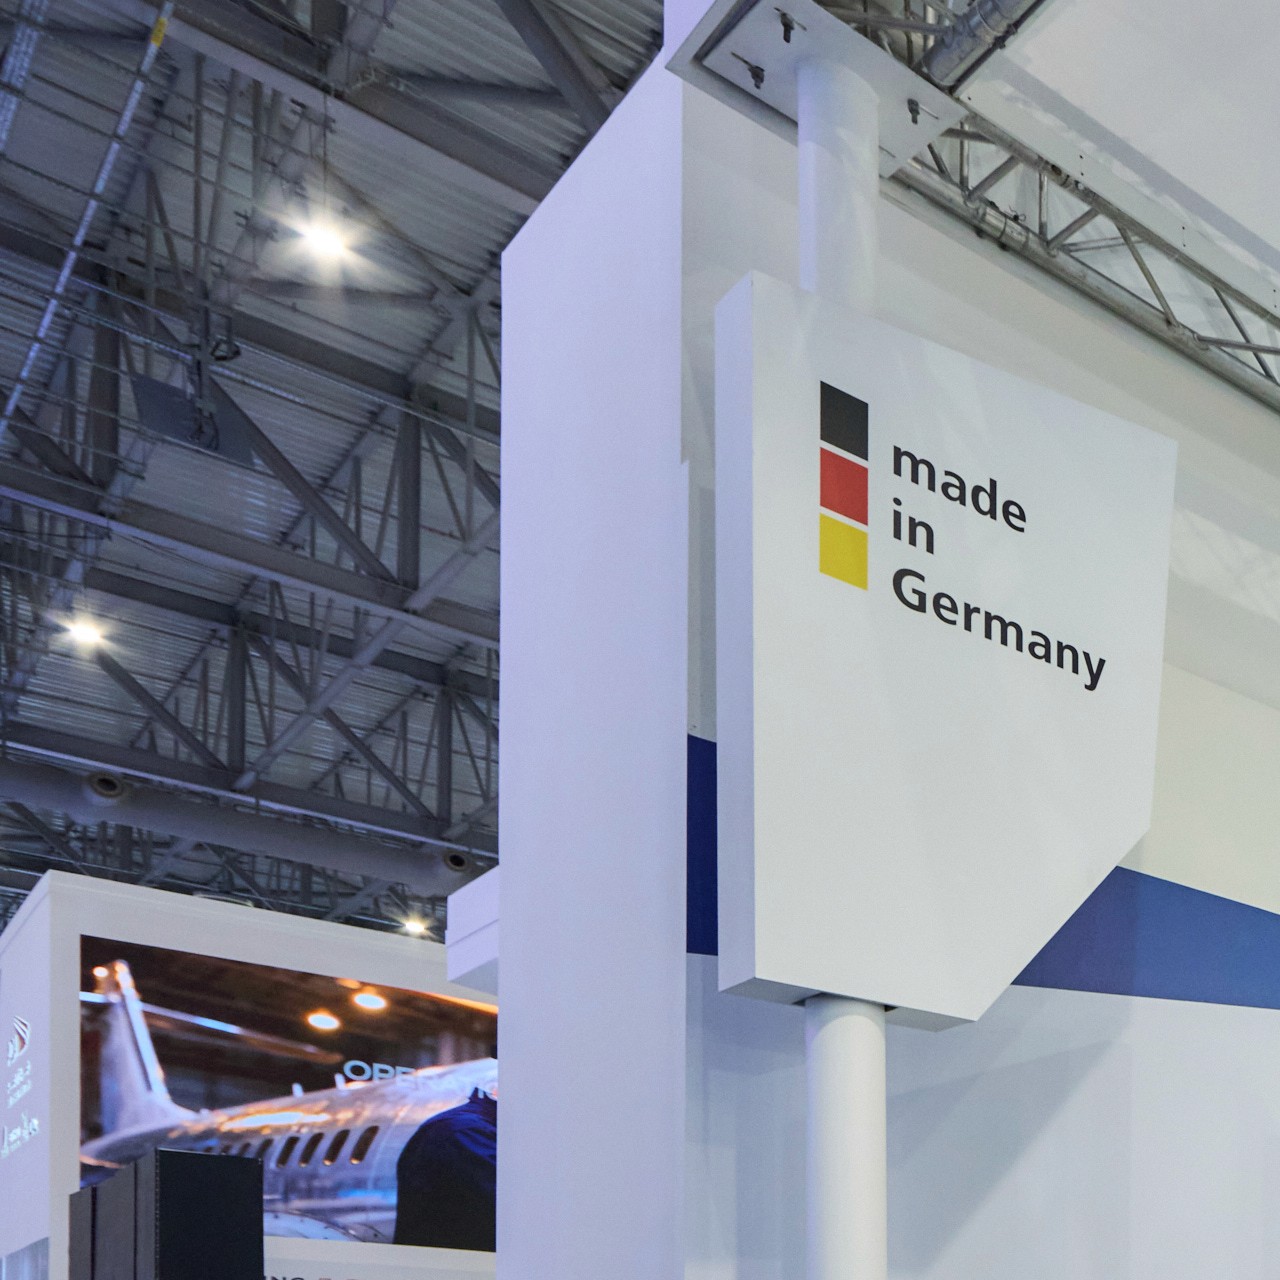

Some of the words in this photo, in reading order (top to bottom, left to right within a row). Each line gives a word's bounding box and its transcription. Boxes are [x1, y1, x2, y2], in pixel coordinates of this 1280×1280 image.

[893, 445, 1026, 533] made
[893, 497, 934, 555] in
[892, 568, 1107, 692] Germany
